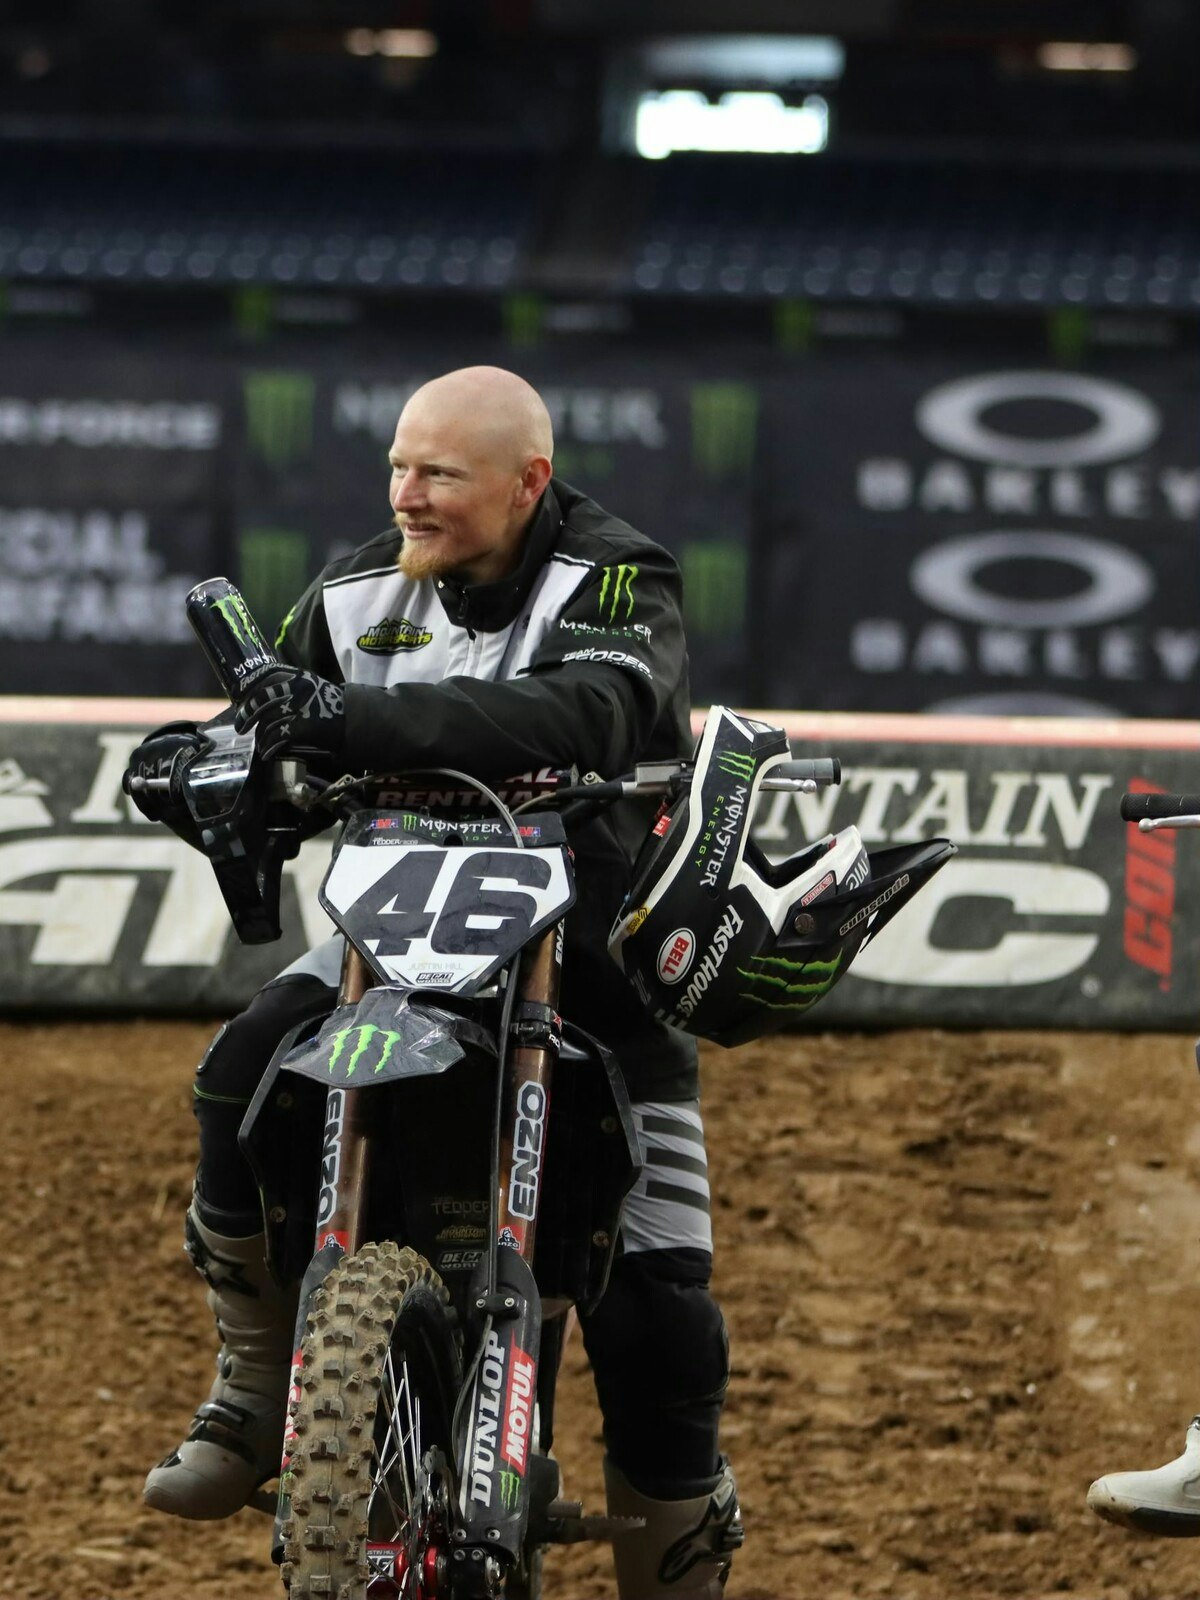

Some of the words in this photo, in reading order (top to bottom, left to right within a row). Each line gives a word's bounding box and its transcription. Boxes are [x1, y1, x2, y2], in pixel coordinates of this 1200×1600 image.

[37, 404, 221, 451] FORCE
[419, 818, 503, 835] MONSTER
[695, 795, 725, 868] ENERGY
[699, 785, 749, 887] MONSTER
[342, 851, 552, 955] 46
[662, 936, 690, 976] BELL
[317, 1088, 346, 1229] ENZO
[508, 1080, 547, 1222] ENZO
[470, 1329, 506, 1508] DUNLOP
[505, 1361, 534, 1467] MOTUL
